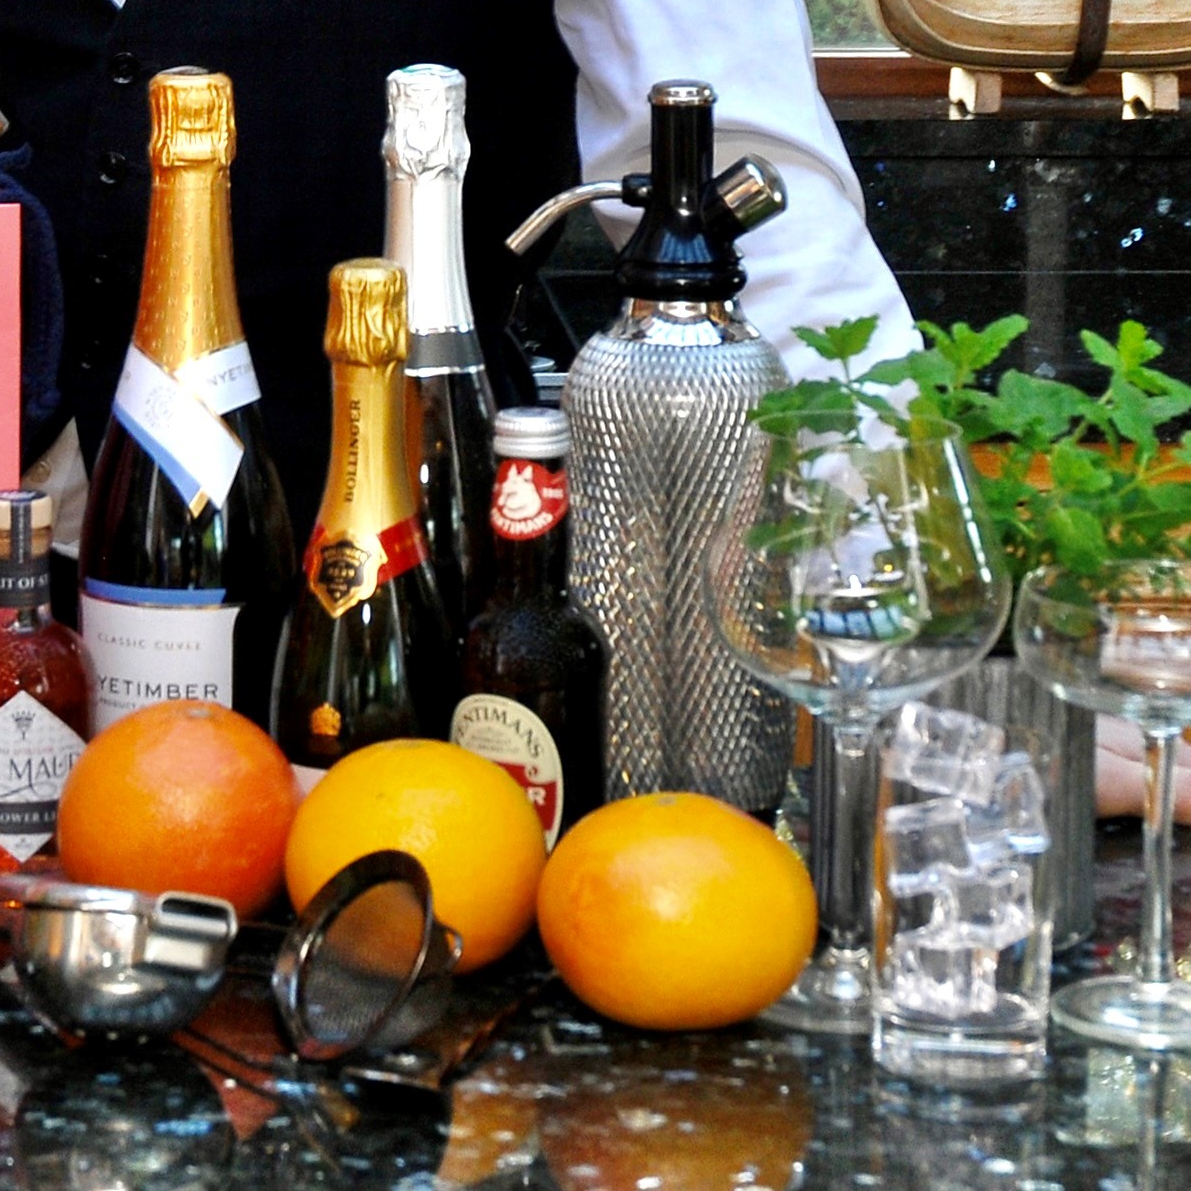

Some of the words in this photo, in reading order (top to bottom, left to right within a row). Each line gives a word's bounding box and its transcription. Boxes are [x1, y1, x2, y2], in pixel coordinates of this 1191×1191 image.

[344, 398, 362, 504] BOLLINGER
[98, 632, 146, 649] CLASSIC
[98, 674, 219, 701] YETIMBER
